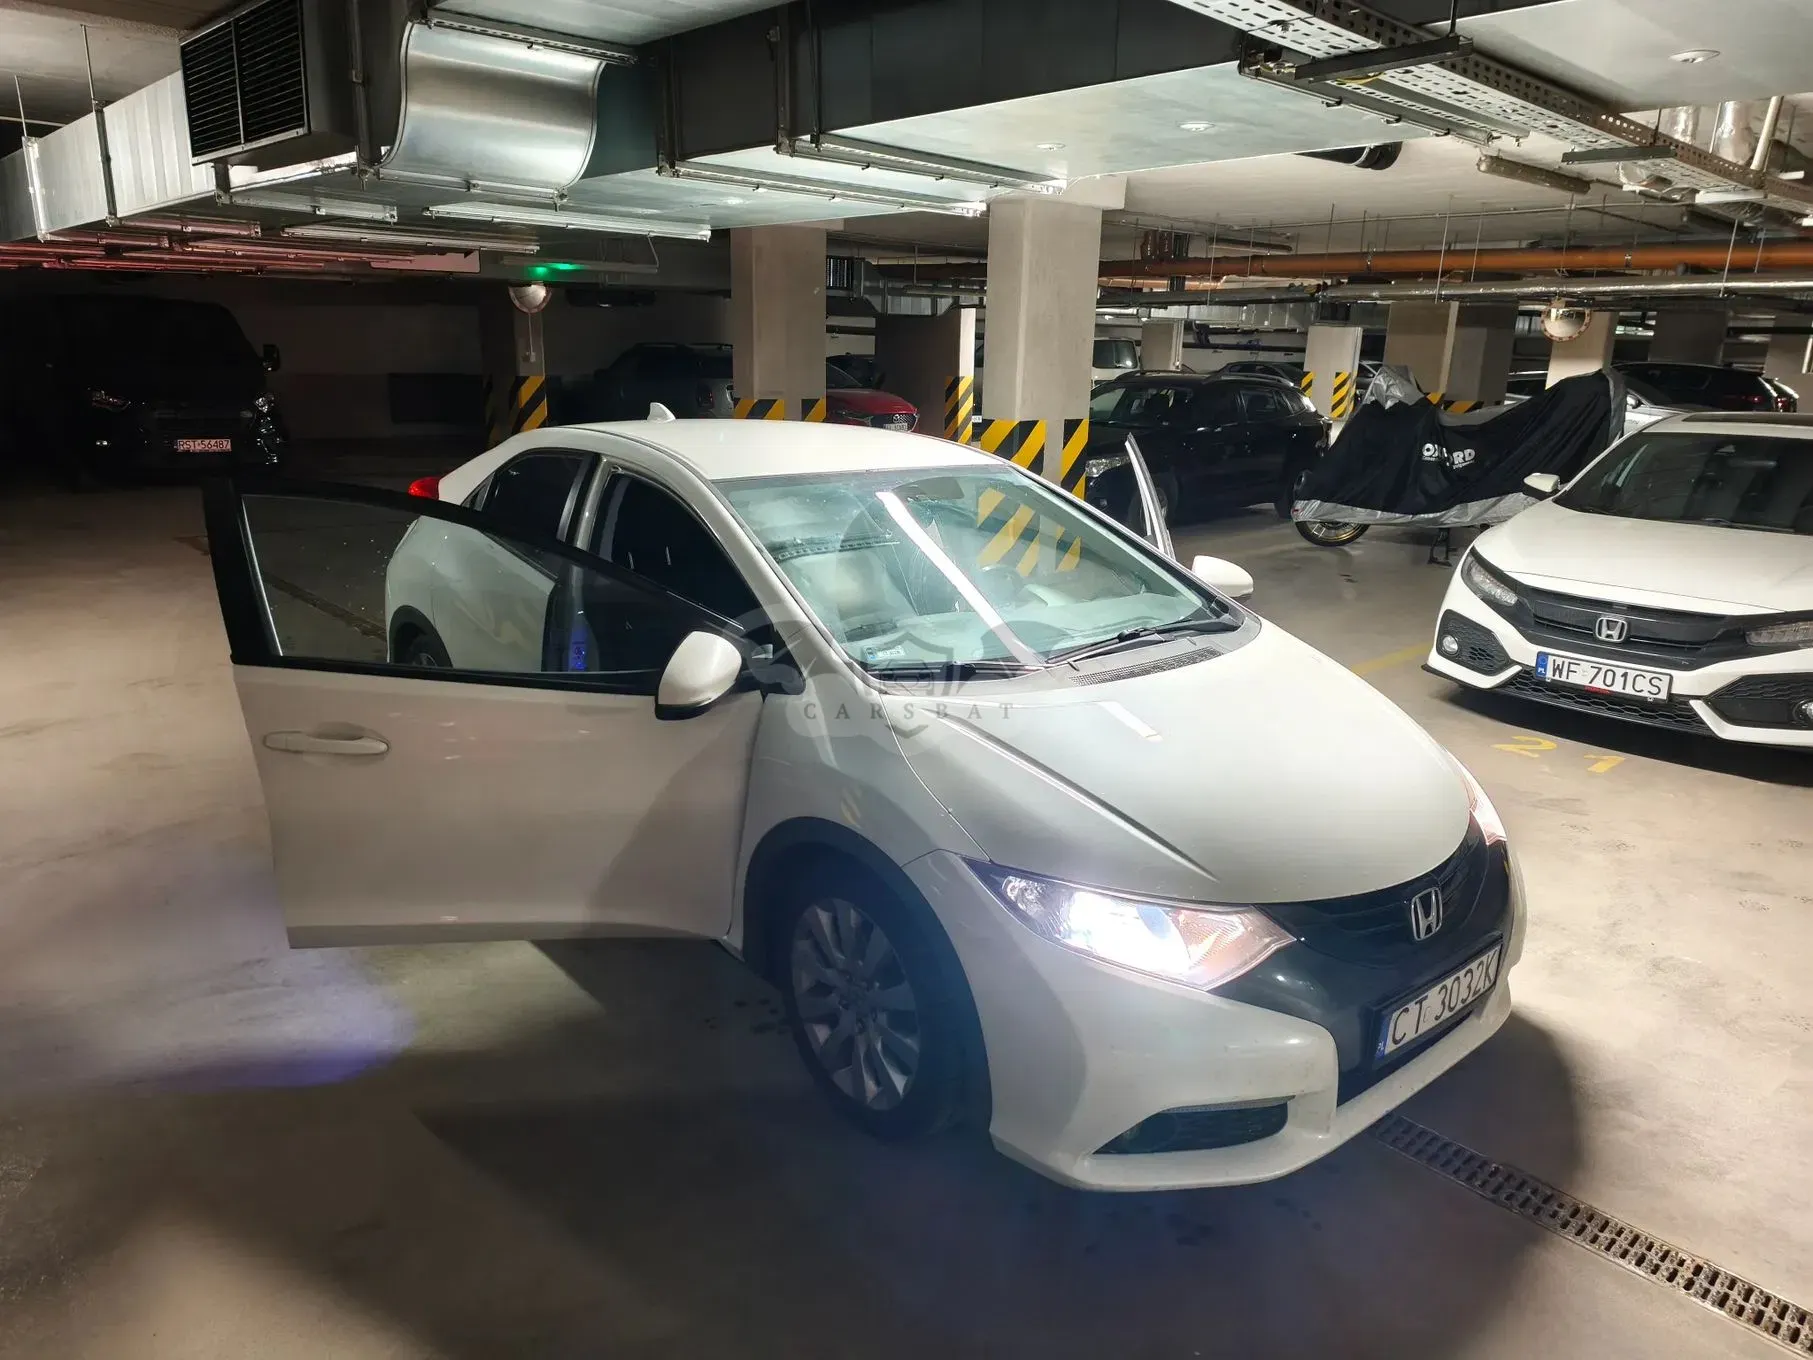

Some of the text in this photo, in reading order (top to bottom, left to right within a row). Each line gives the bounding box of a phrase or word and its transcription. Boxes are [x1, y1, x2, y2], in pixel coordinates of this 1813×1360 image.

[178, 440, 229, 449] RST 56487
[1552, 658, 1663, 696] WF 701CS
[1391, 949, 1499, 1046] CT 3032K
